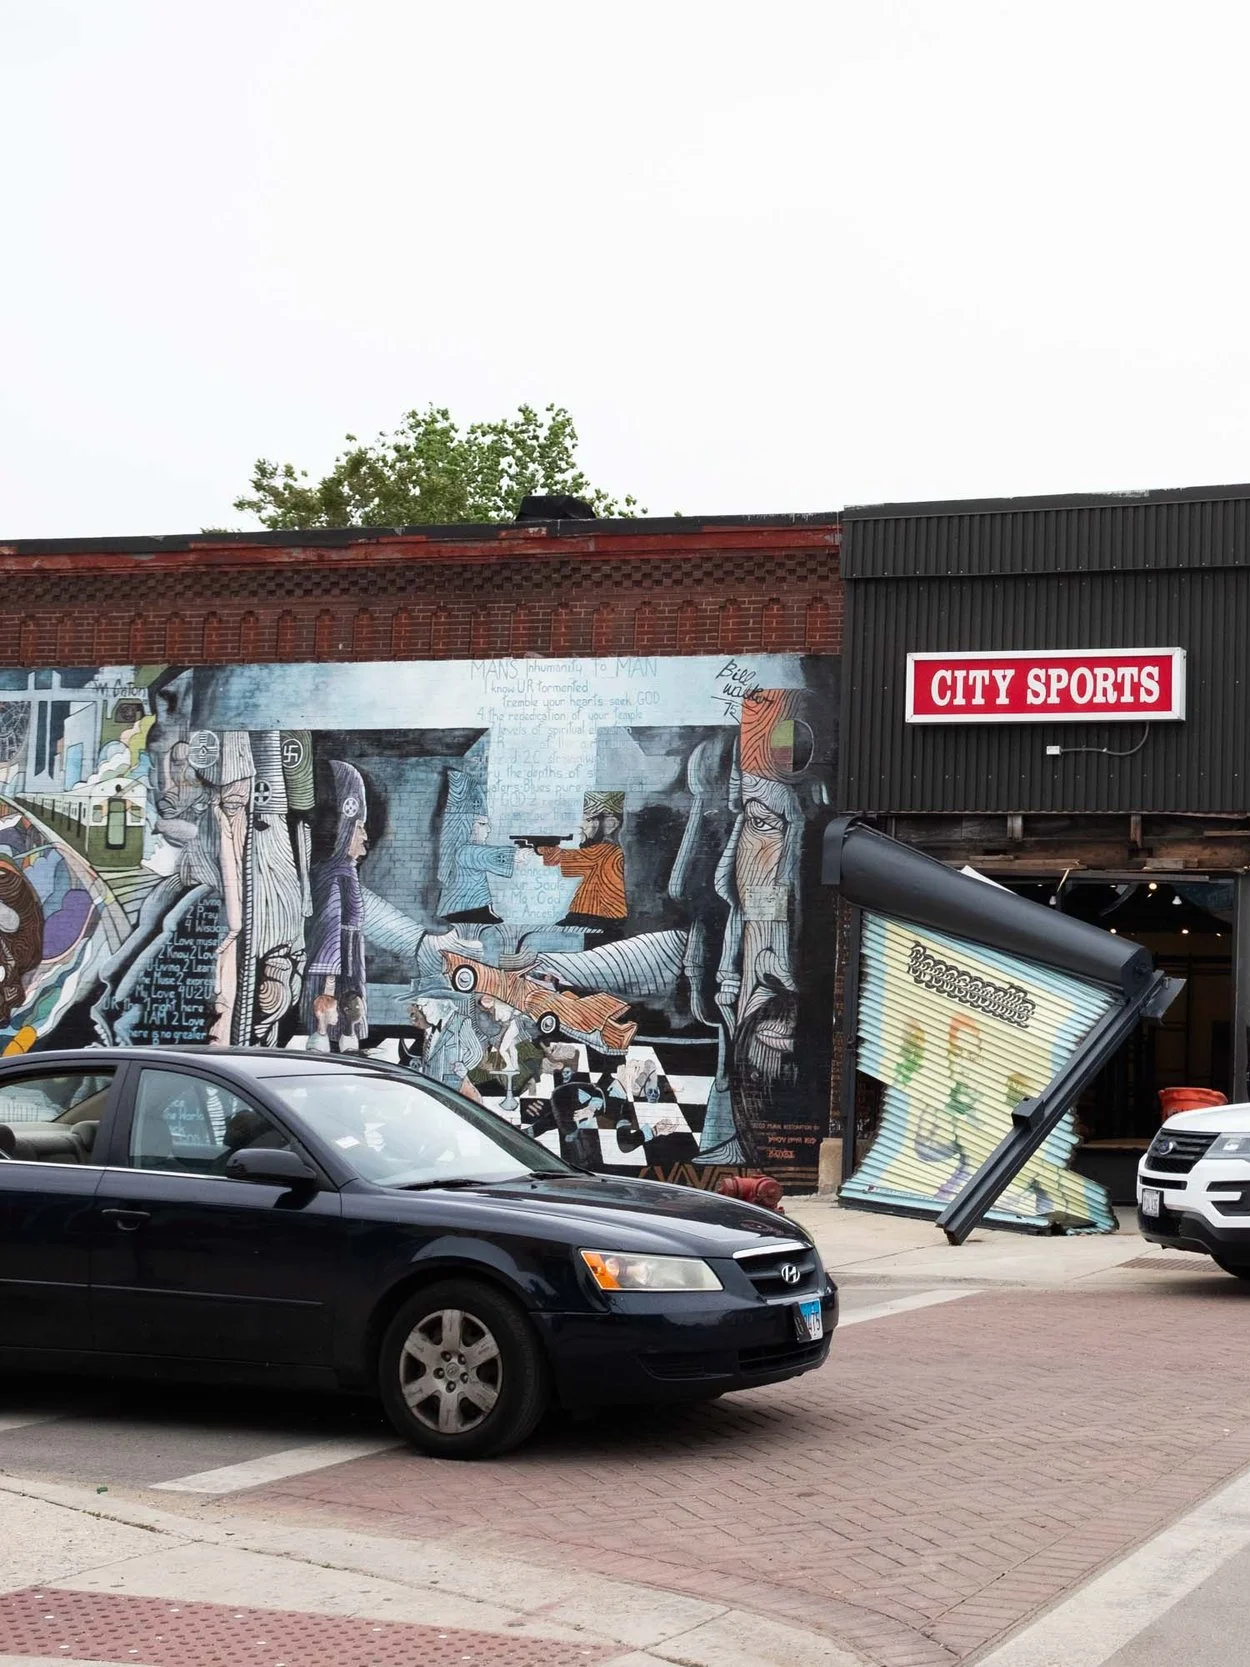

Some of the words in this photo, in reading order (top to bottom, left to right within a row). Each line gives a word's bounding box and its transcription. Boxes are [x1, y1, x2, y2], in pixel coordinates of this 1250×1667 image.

[470, 660, 519, 680] MANS
[526, 659, 583, 680] Inhumanity
[615, 659, 658, 679] MAN
[715, 658, 757, 686] Bill
[491, 681, 516, 694] know
[931, 668, 1015, 707] CITY
[1026, 665, 1160, 706] SPORTS
[197, 906, 219, 920] Pray
[152, 985, 175, 998] Love
[182, 1012, 206, 1026] Love
